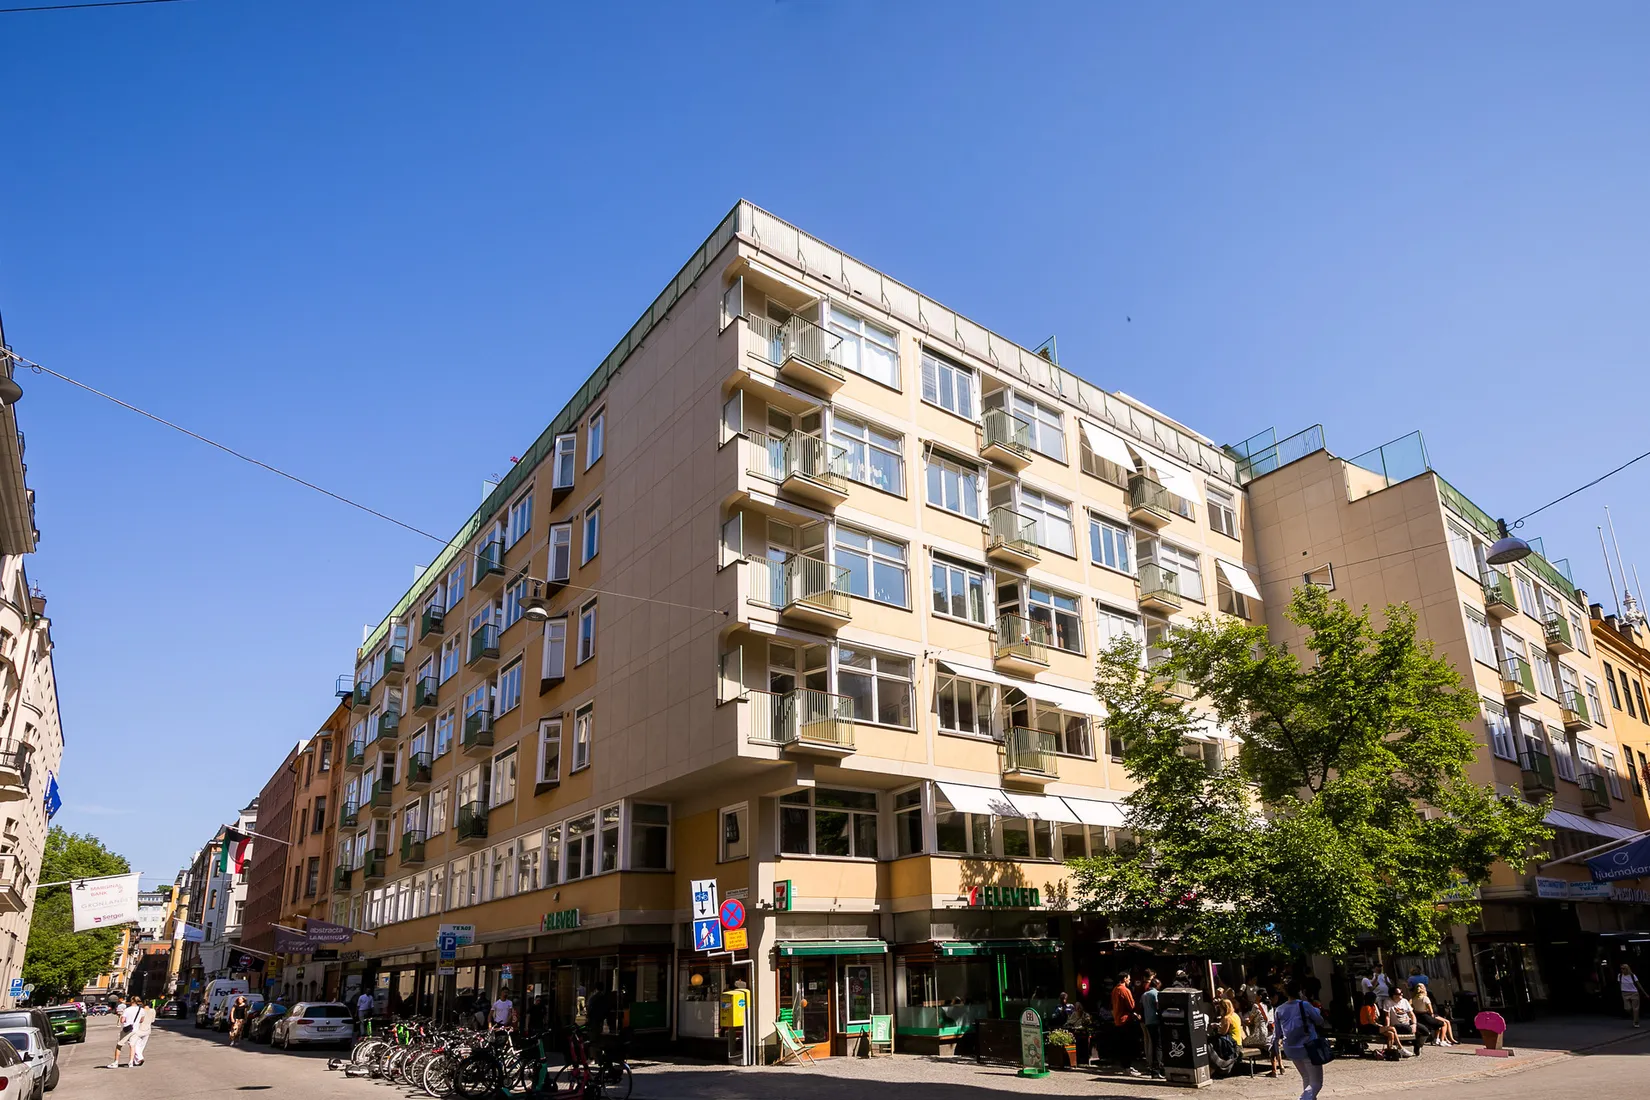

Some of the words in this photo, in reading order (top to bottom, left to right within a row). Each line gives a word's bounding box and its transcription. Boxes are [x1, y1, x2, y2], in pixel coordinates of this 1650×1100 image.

[1595, 865, 1650, 880] ljudmakar
[445, 937, 454, 950] P
[214, 987, 244, 997] FedEx
